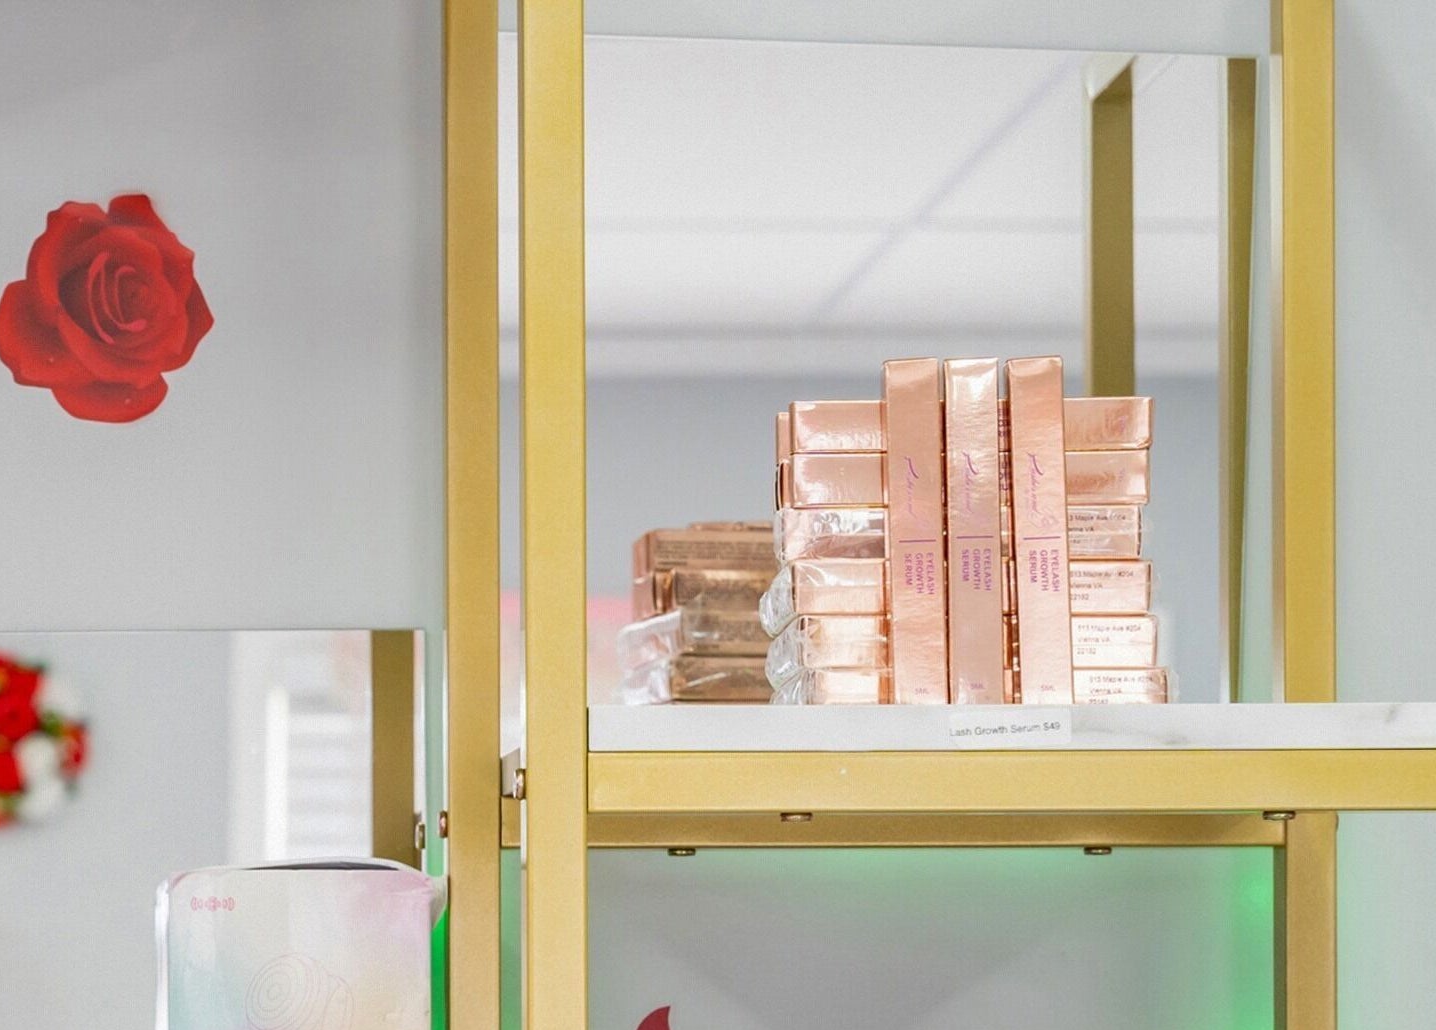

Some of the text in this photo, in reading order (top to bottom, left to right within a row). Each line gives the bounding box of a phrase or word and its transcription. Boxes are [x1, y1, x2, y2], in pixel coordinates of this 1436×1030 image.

[916, 553, 924, 594] GROWTH
[926, 552, 934, 595] EYELASH
[973, 548, 981, 590] GROWTH
[1029, 550, 1037, 583] SERUM
[1040, 550, 1049, 591] GROWTH
[1051, 549, 1060, 592] EYELASH
[950, 722, 1061, 736] Lash Growth Serum $49
